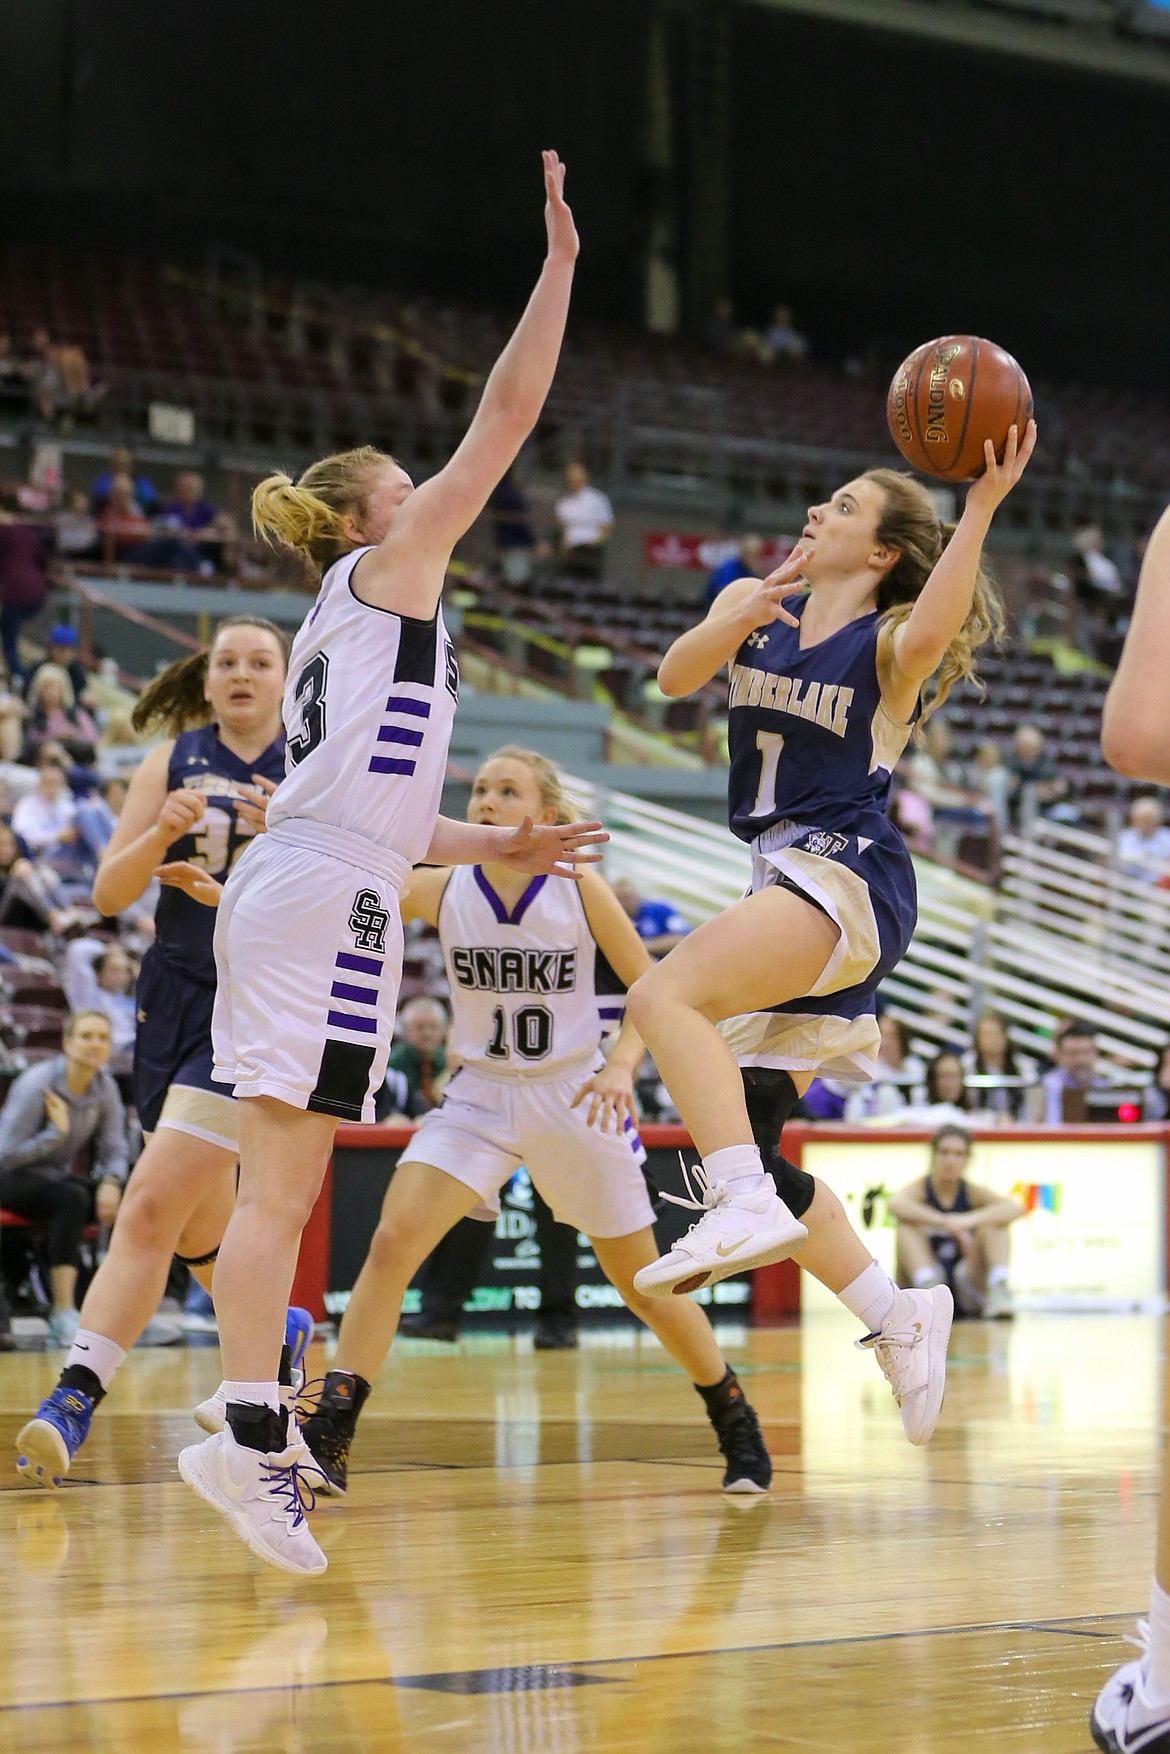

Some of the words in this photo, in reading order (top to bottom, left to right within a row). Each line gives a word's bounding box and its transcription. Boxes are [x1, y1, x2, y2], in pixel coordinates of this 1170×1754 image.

[287, 650, 330, 768] 3
[749, 730, 785, 817] 1
[450, 947, 578, 995] SNAKE
[486, 1004, 554, 1061] 10
